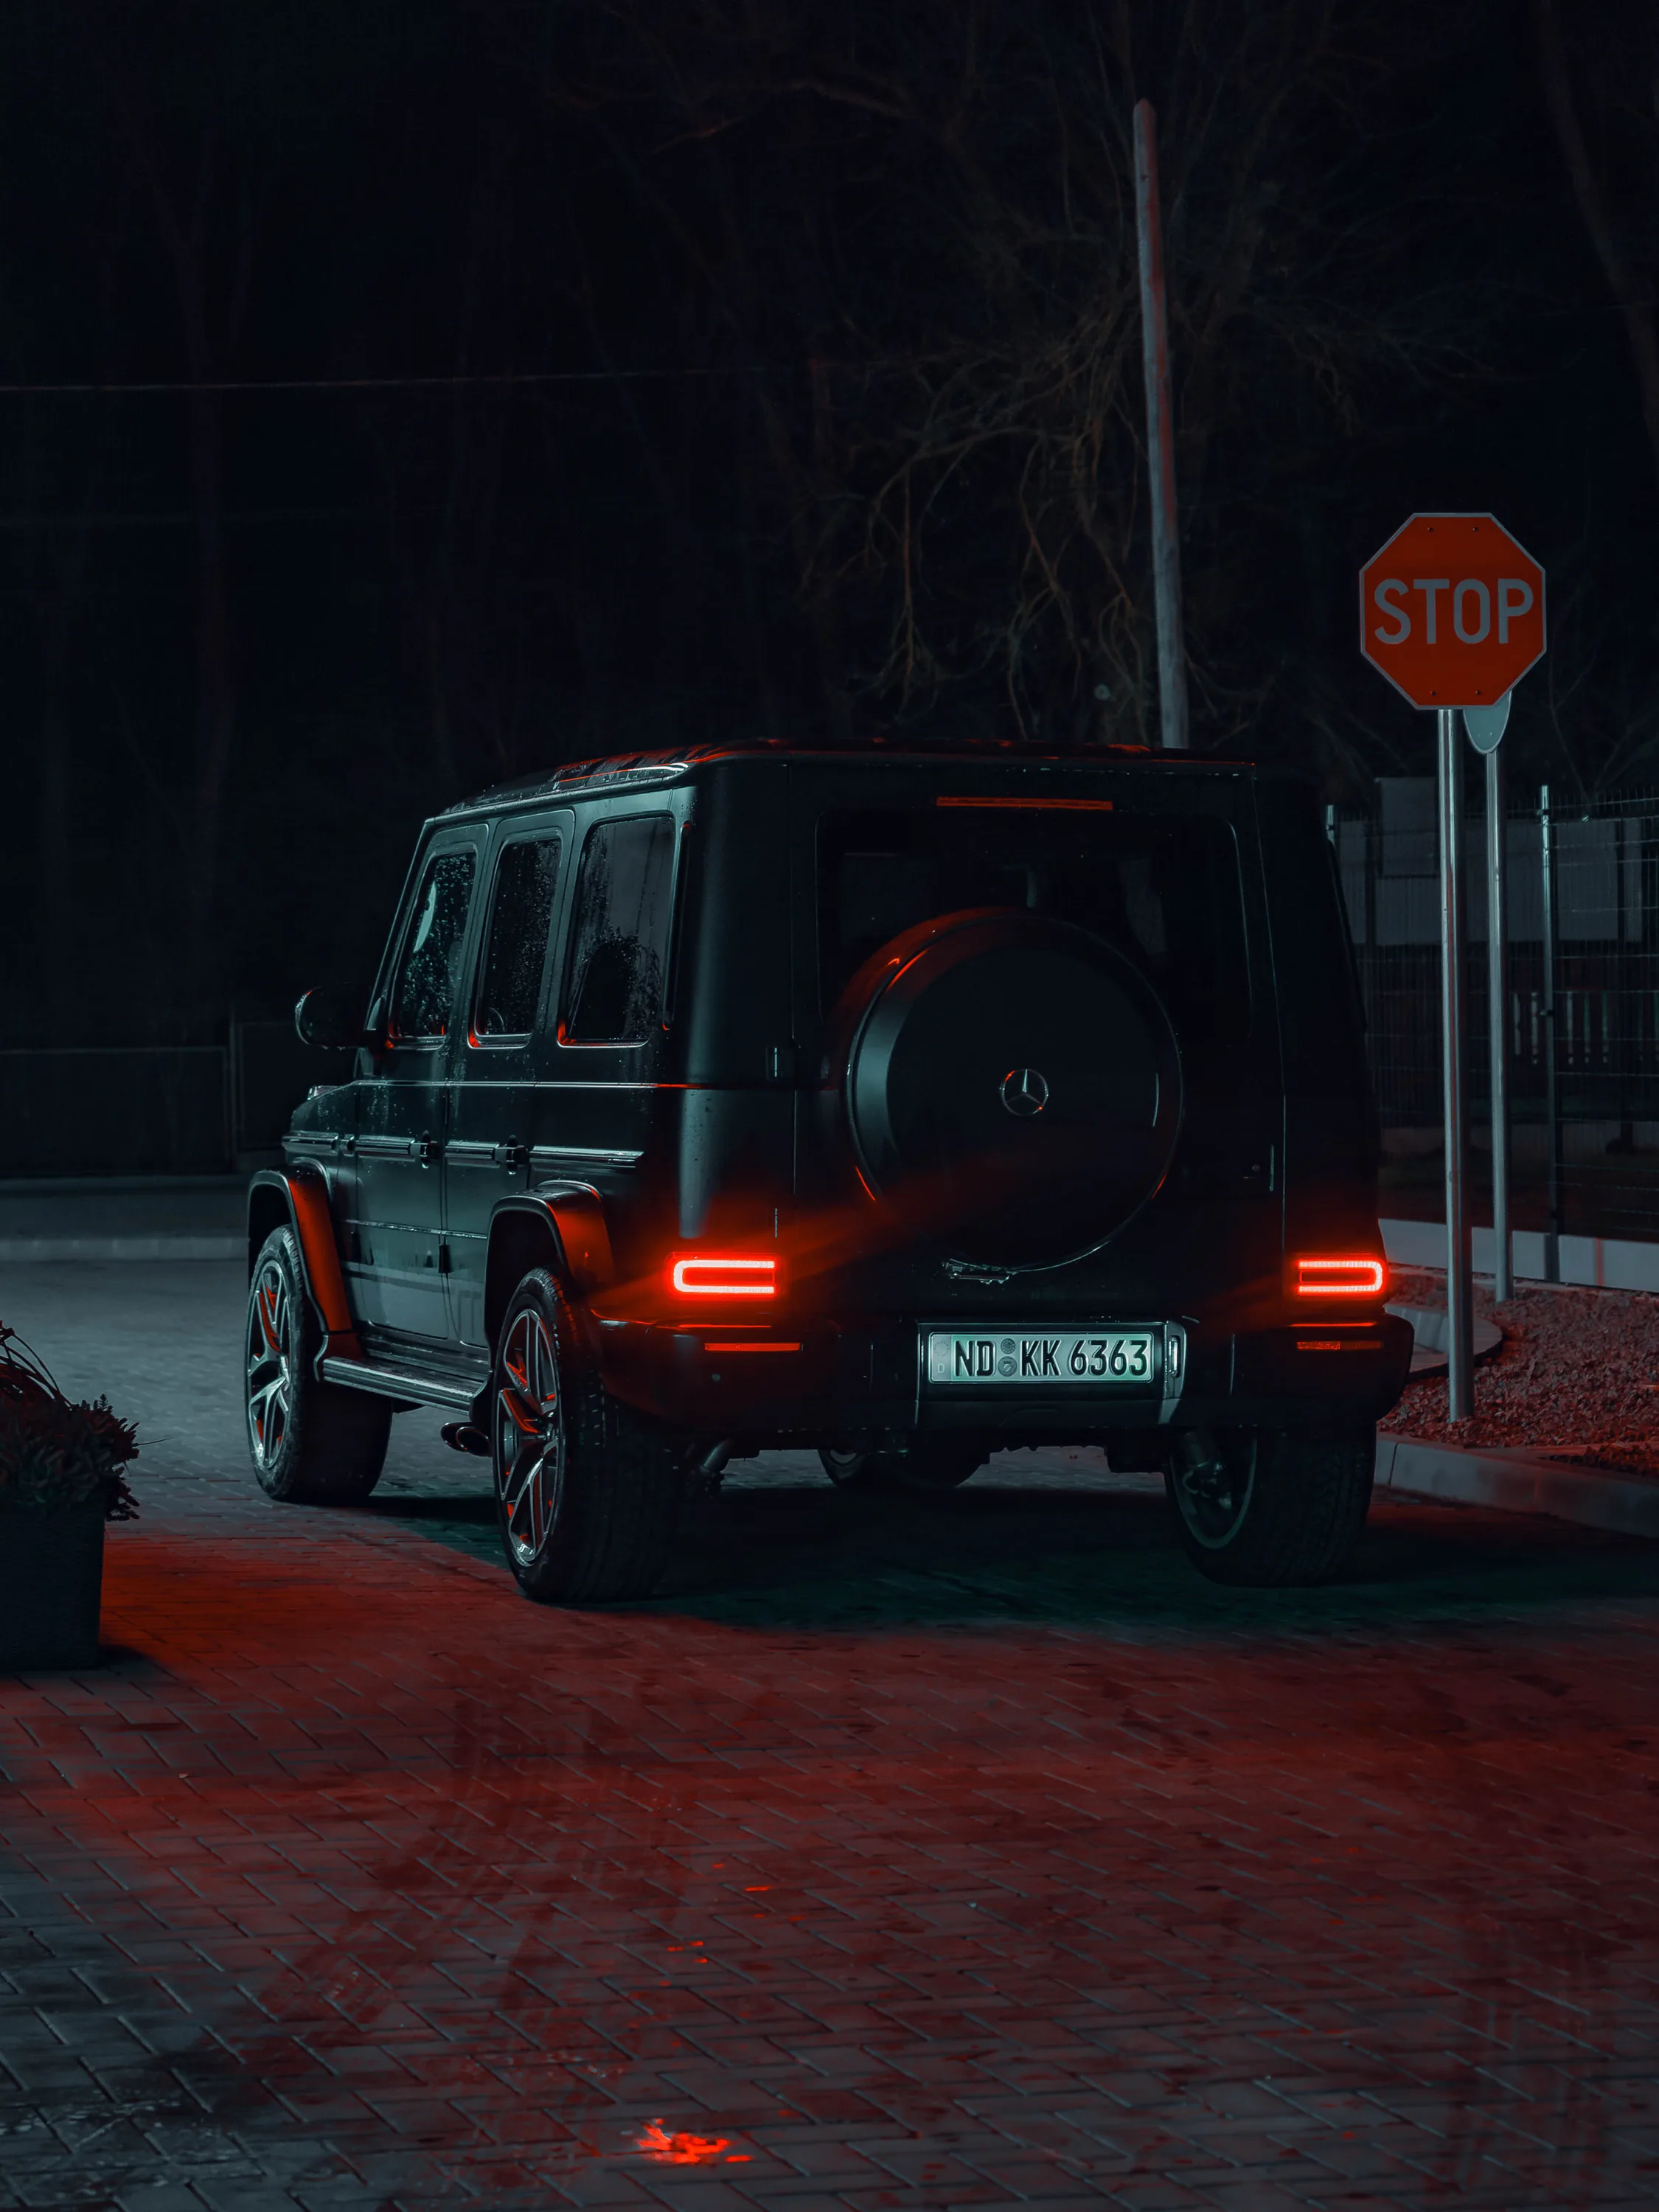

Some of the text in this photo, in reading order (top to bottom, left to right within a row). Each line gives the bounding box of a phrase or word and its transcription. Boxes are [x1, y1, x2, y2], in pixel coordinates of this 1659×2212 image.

[1374, 578, 1534, 644] STOP
[937, 1363, 945, 1373] D
[955, 1340, 1148, 1377] ND KK 6363
